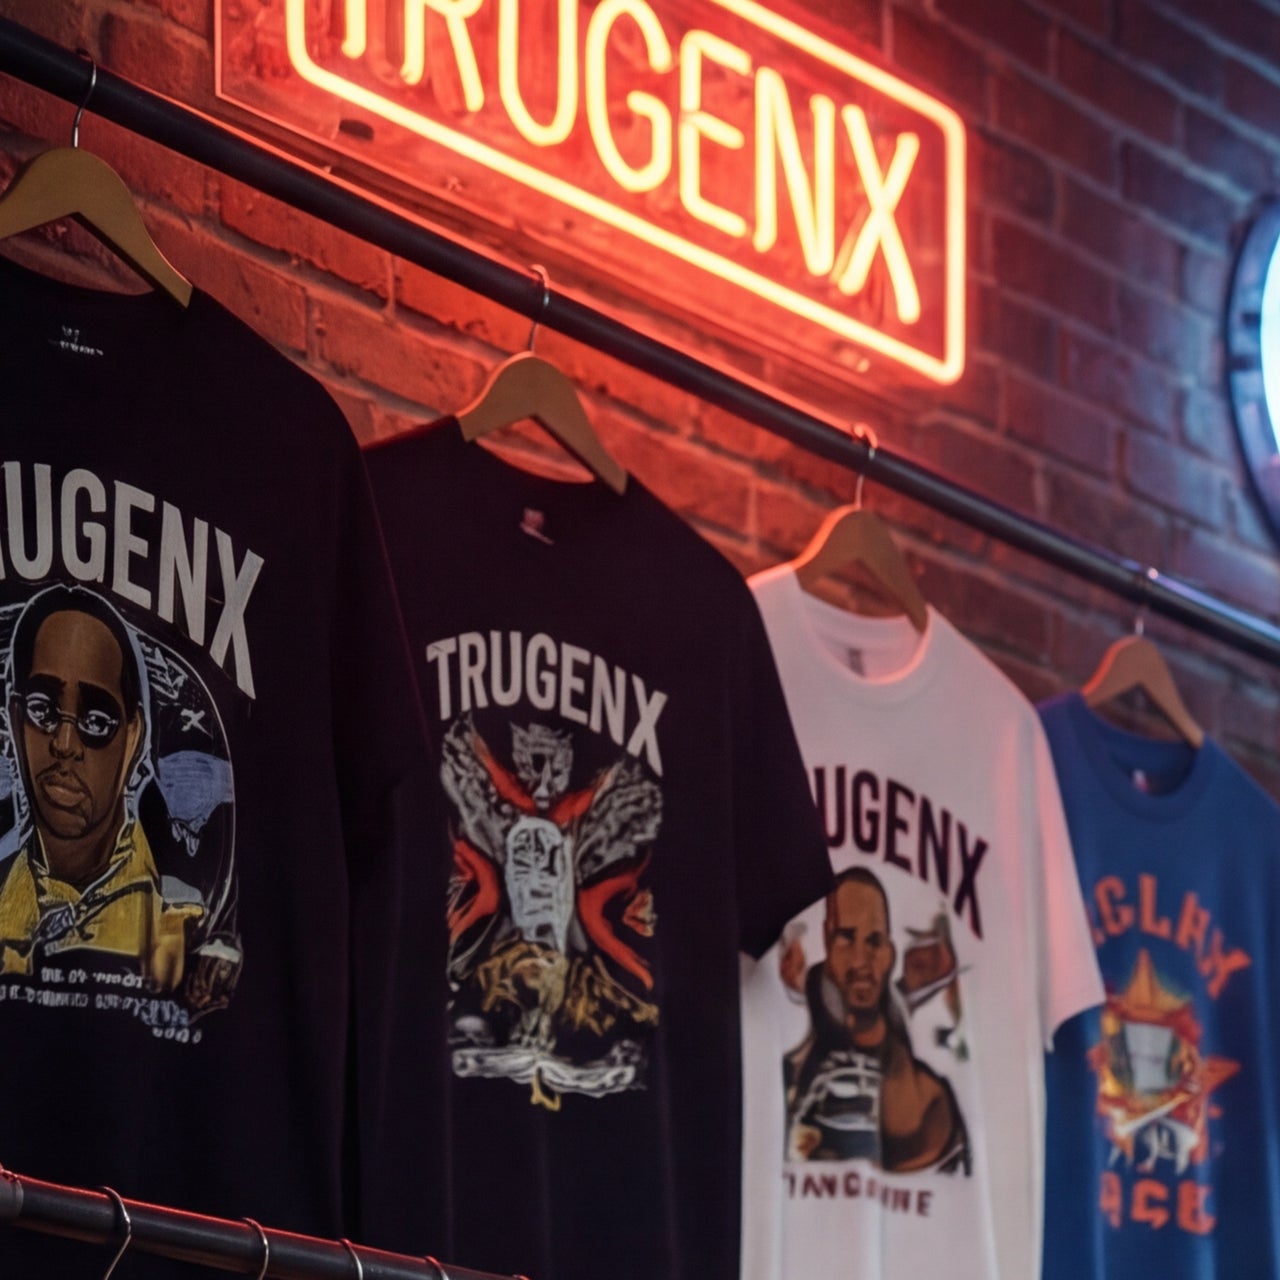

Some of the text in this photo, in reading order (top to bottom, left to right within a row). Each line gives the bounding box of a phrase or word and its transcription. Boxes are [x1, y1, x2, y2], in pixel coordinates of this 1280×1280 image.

[342, 0, 922, 324] RUGENX
[0, 460, 265, 700] UGENX
[426, 629, 668, 777] TRUGENX
